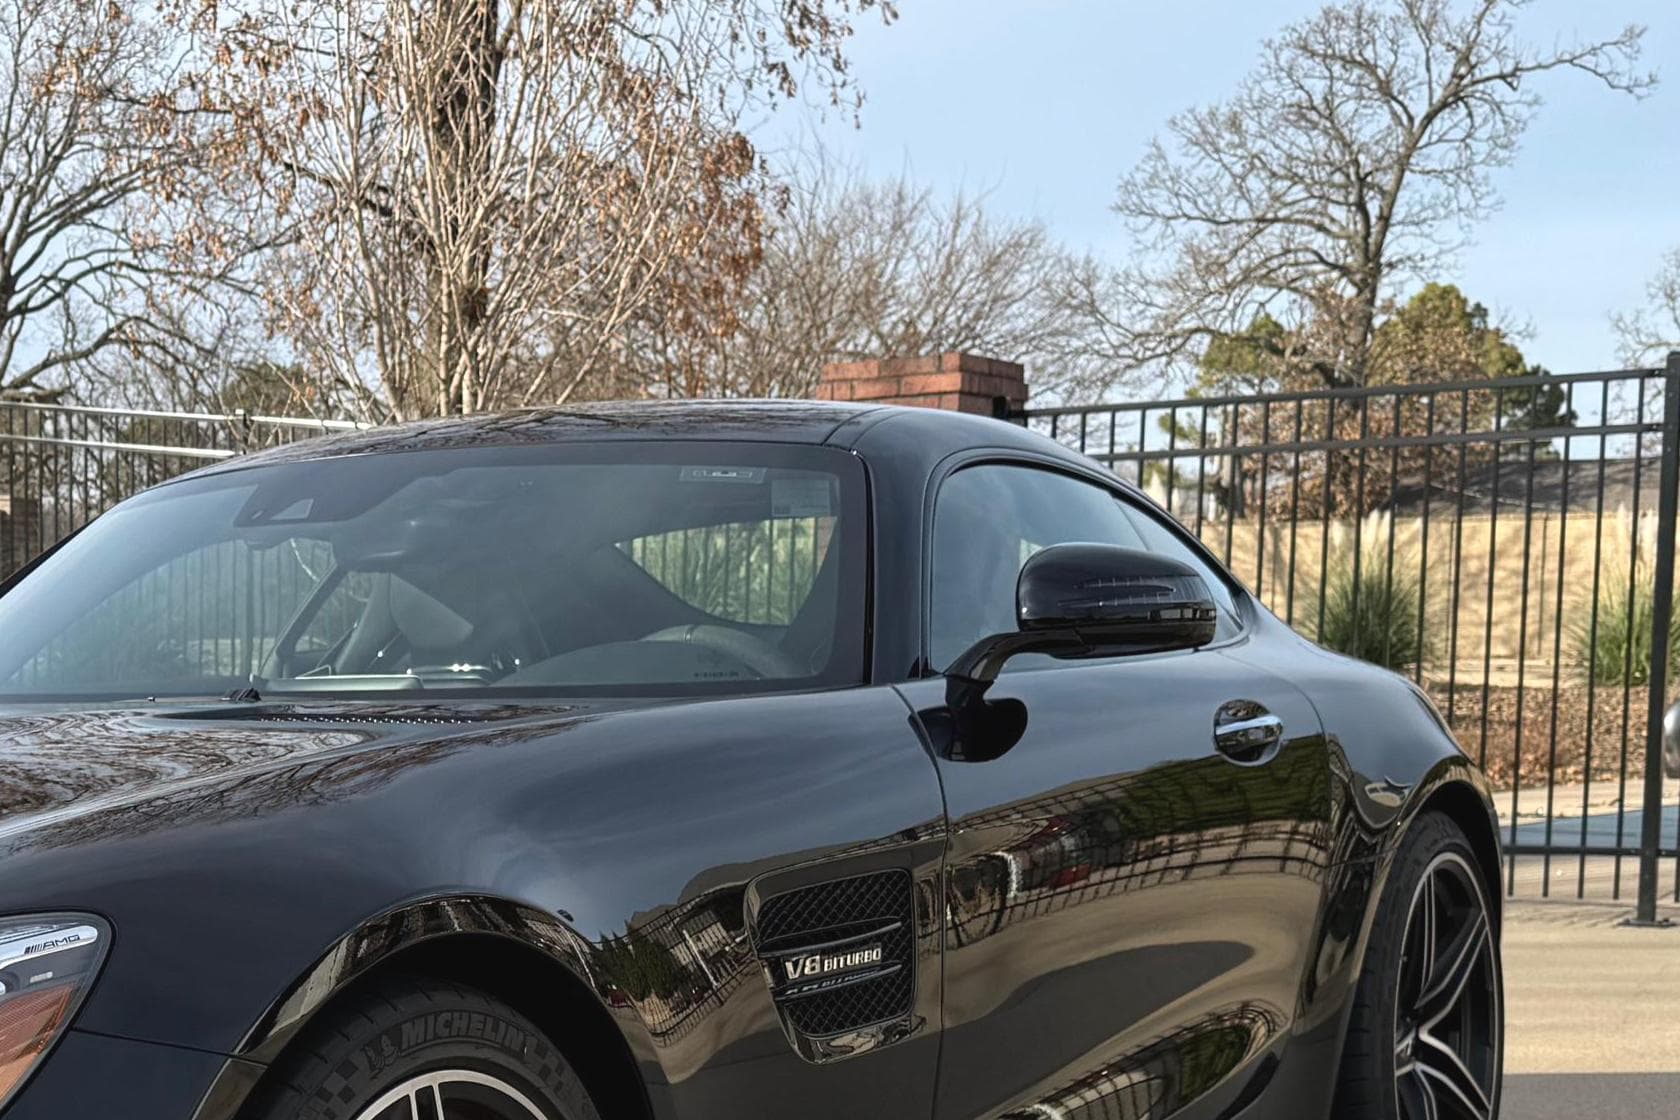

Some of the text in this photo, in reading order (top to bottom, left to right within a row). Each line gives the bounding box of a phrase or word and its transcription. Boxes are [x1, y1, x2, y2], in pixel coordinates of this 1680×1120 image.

[41, 934, 80, 951] AMG
[785, 948, 881, 980] V8 BITURBO
[401, 1010, 524, 1050] MICHELIN
